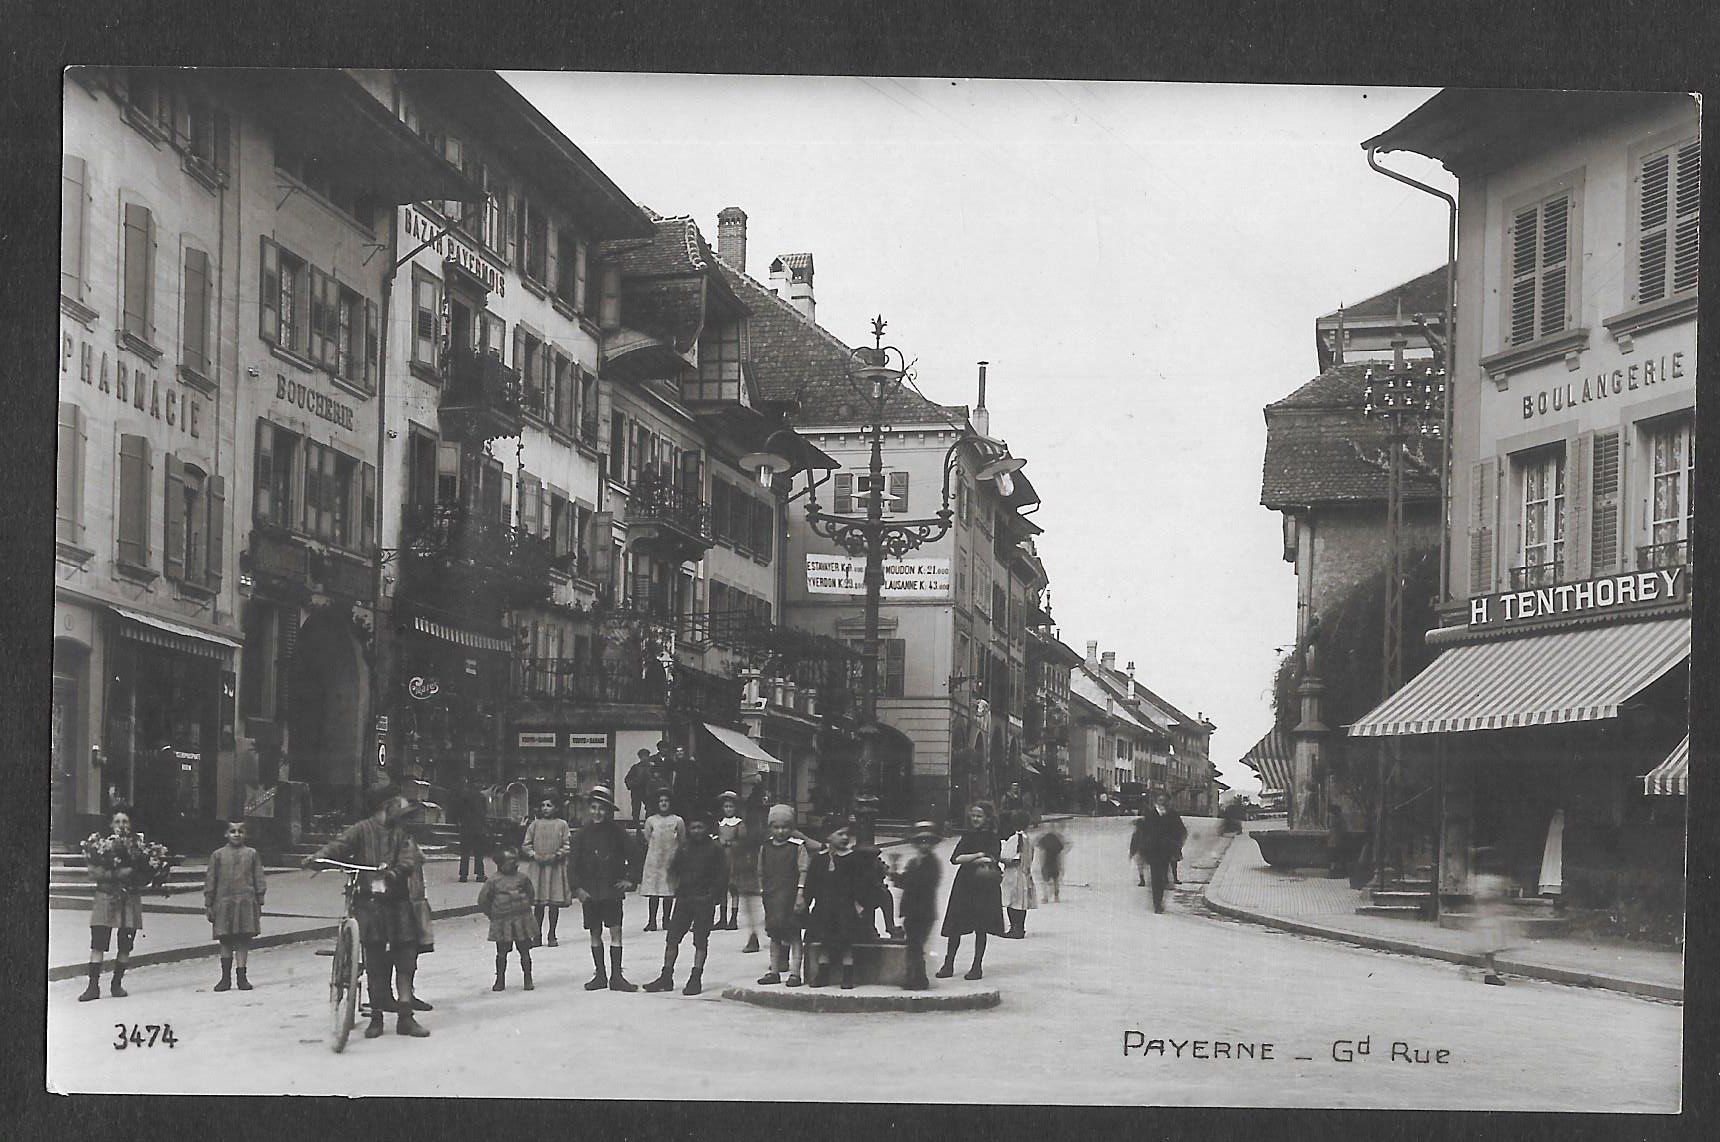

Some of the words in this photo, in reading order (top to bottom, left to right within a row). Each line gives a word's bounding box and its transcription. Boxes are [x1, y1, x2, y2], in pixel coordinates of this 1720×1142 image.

[405, 207, 442, 256] BAZAR
[62, 330, 200, 439] PHARMACIE
[276, 373, 355, 432] BOUCHERIE
[1523, 351, 1685, 420] BOULANGERIE
[884, 580, 918, 590] LAUSANNE
[885, 565, 915, 575] MOUDON
[1470, 598, 1494, 625] H.
[1499, 567, 1681, 621] TENTHOREY
